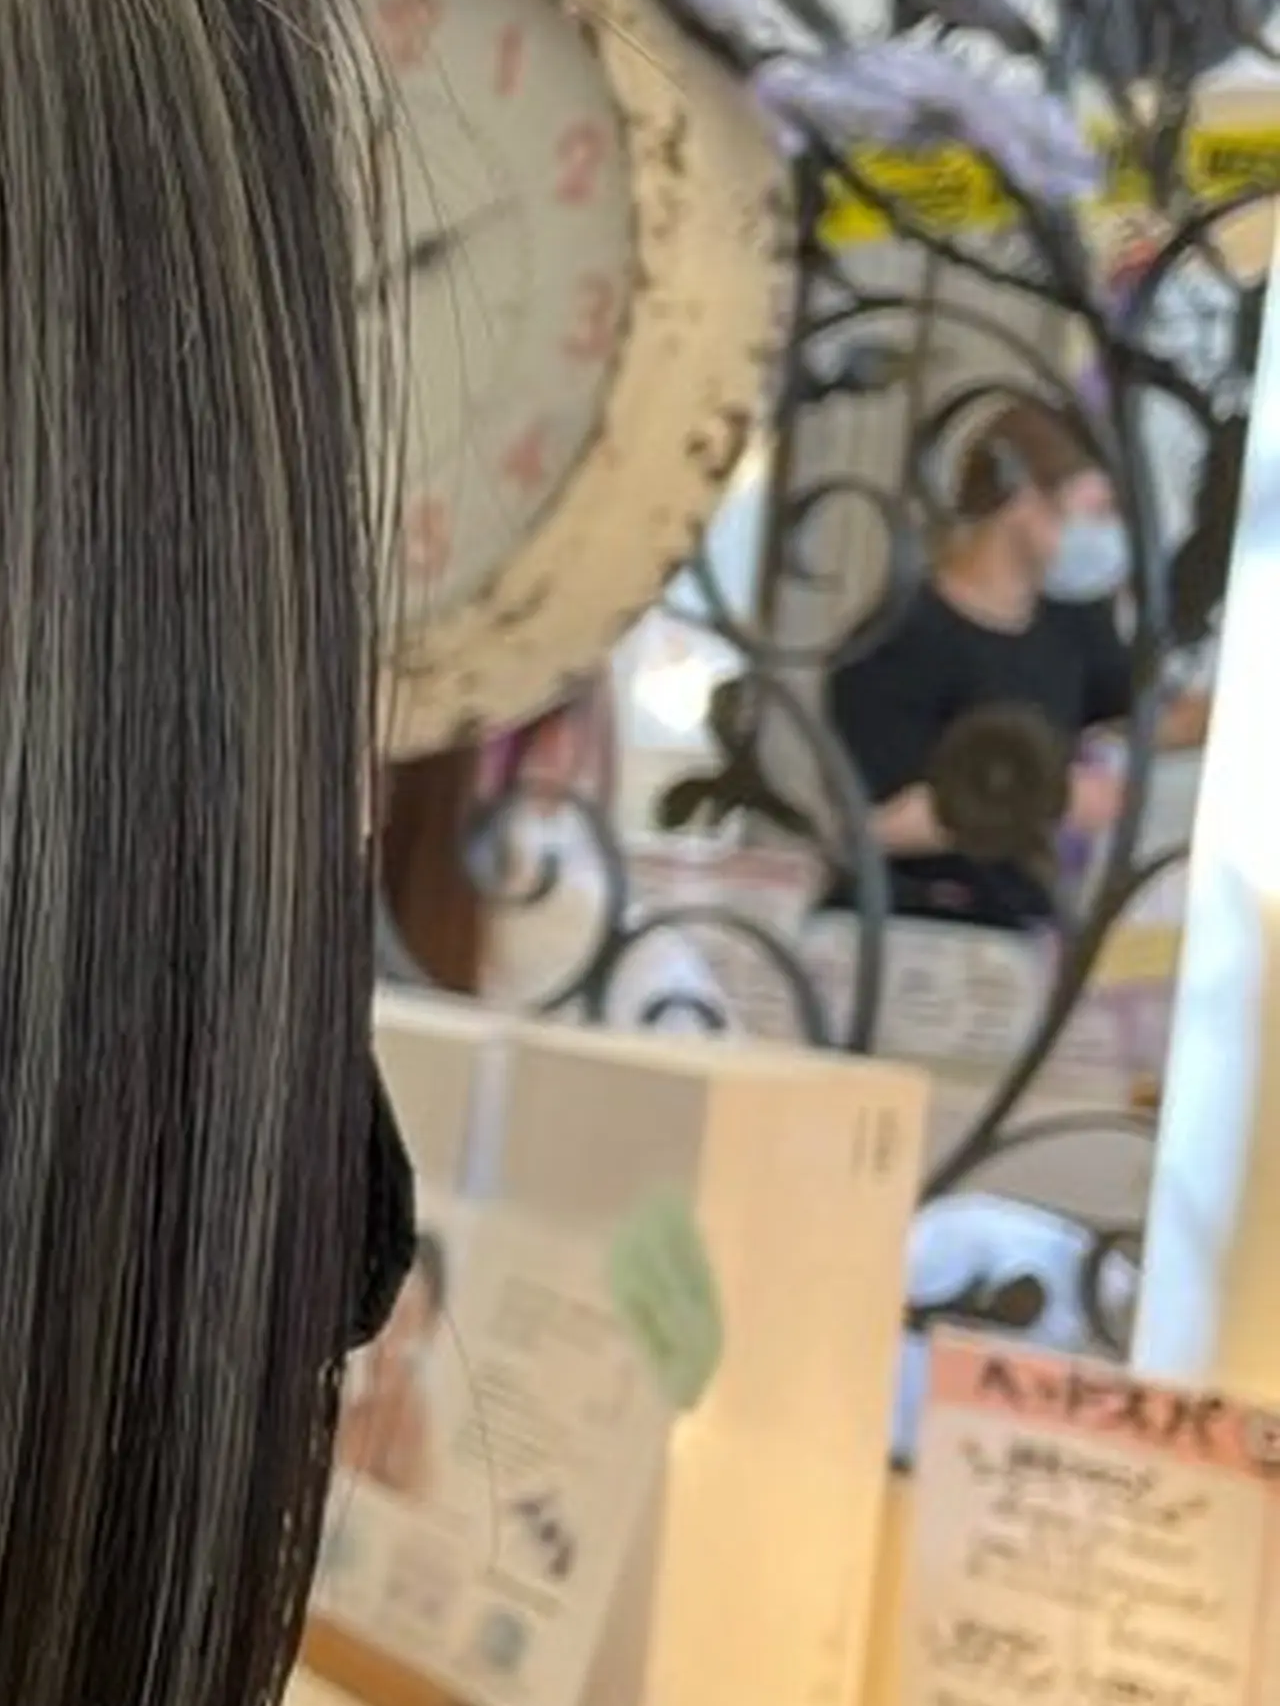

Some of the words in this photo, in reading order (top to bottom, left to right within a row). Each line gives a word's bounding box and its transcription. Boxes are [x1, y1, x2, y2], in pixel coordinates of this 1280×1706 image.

[496, 23, 525, 99] 1
[556, 121, 612, 205] 2
[564, 269, 617, 361] 3
